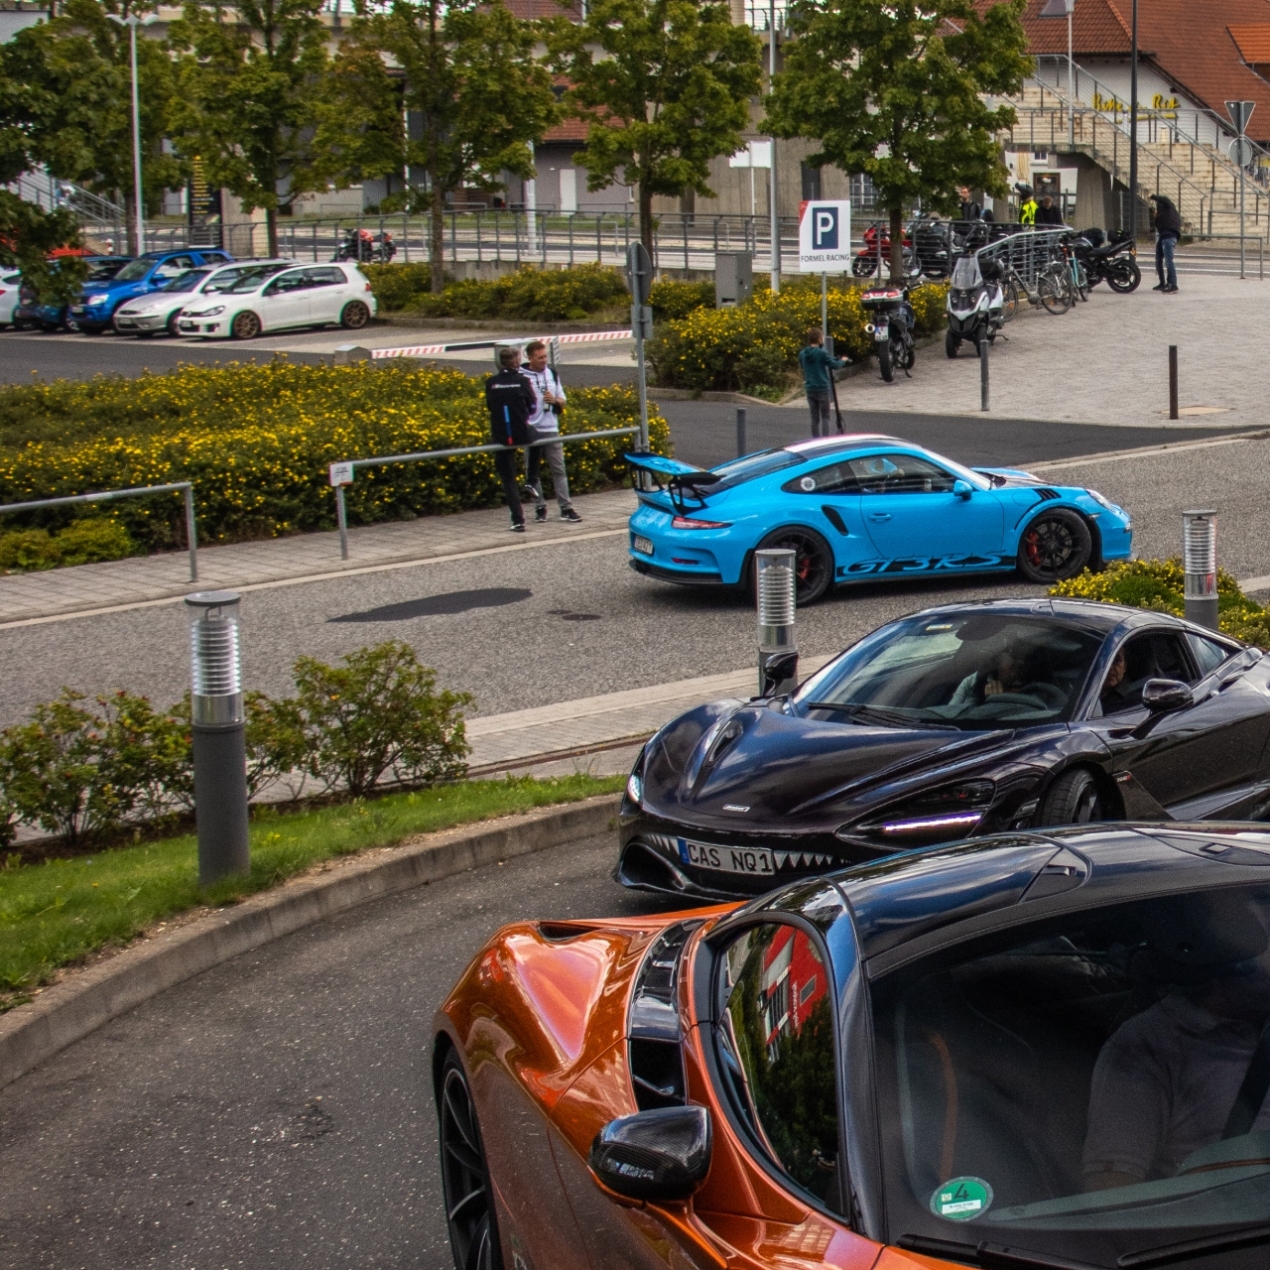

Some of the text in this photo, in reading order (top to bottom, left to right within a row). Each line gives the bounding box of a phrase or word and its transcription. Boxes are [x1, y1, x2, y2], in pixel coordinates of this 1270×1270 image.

[817, 212, 834, 245] P
[801, 253, 849, 262] FORMEL RACING
[687, 844, 721, 867] CAS
[954, 1183, 969, 1200] 4
